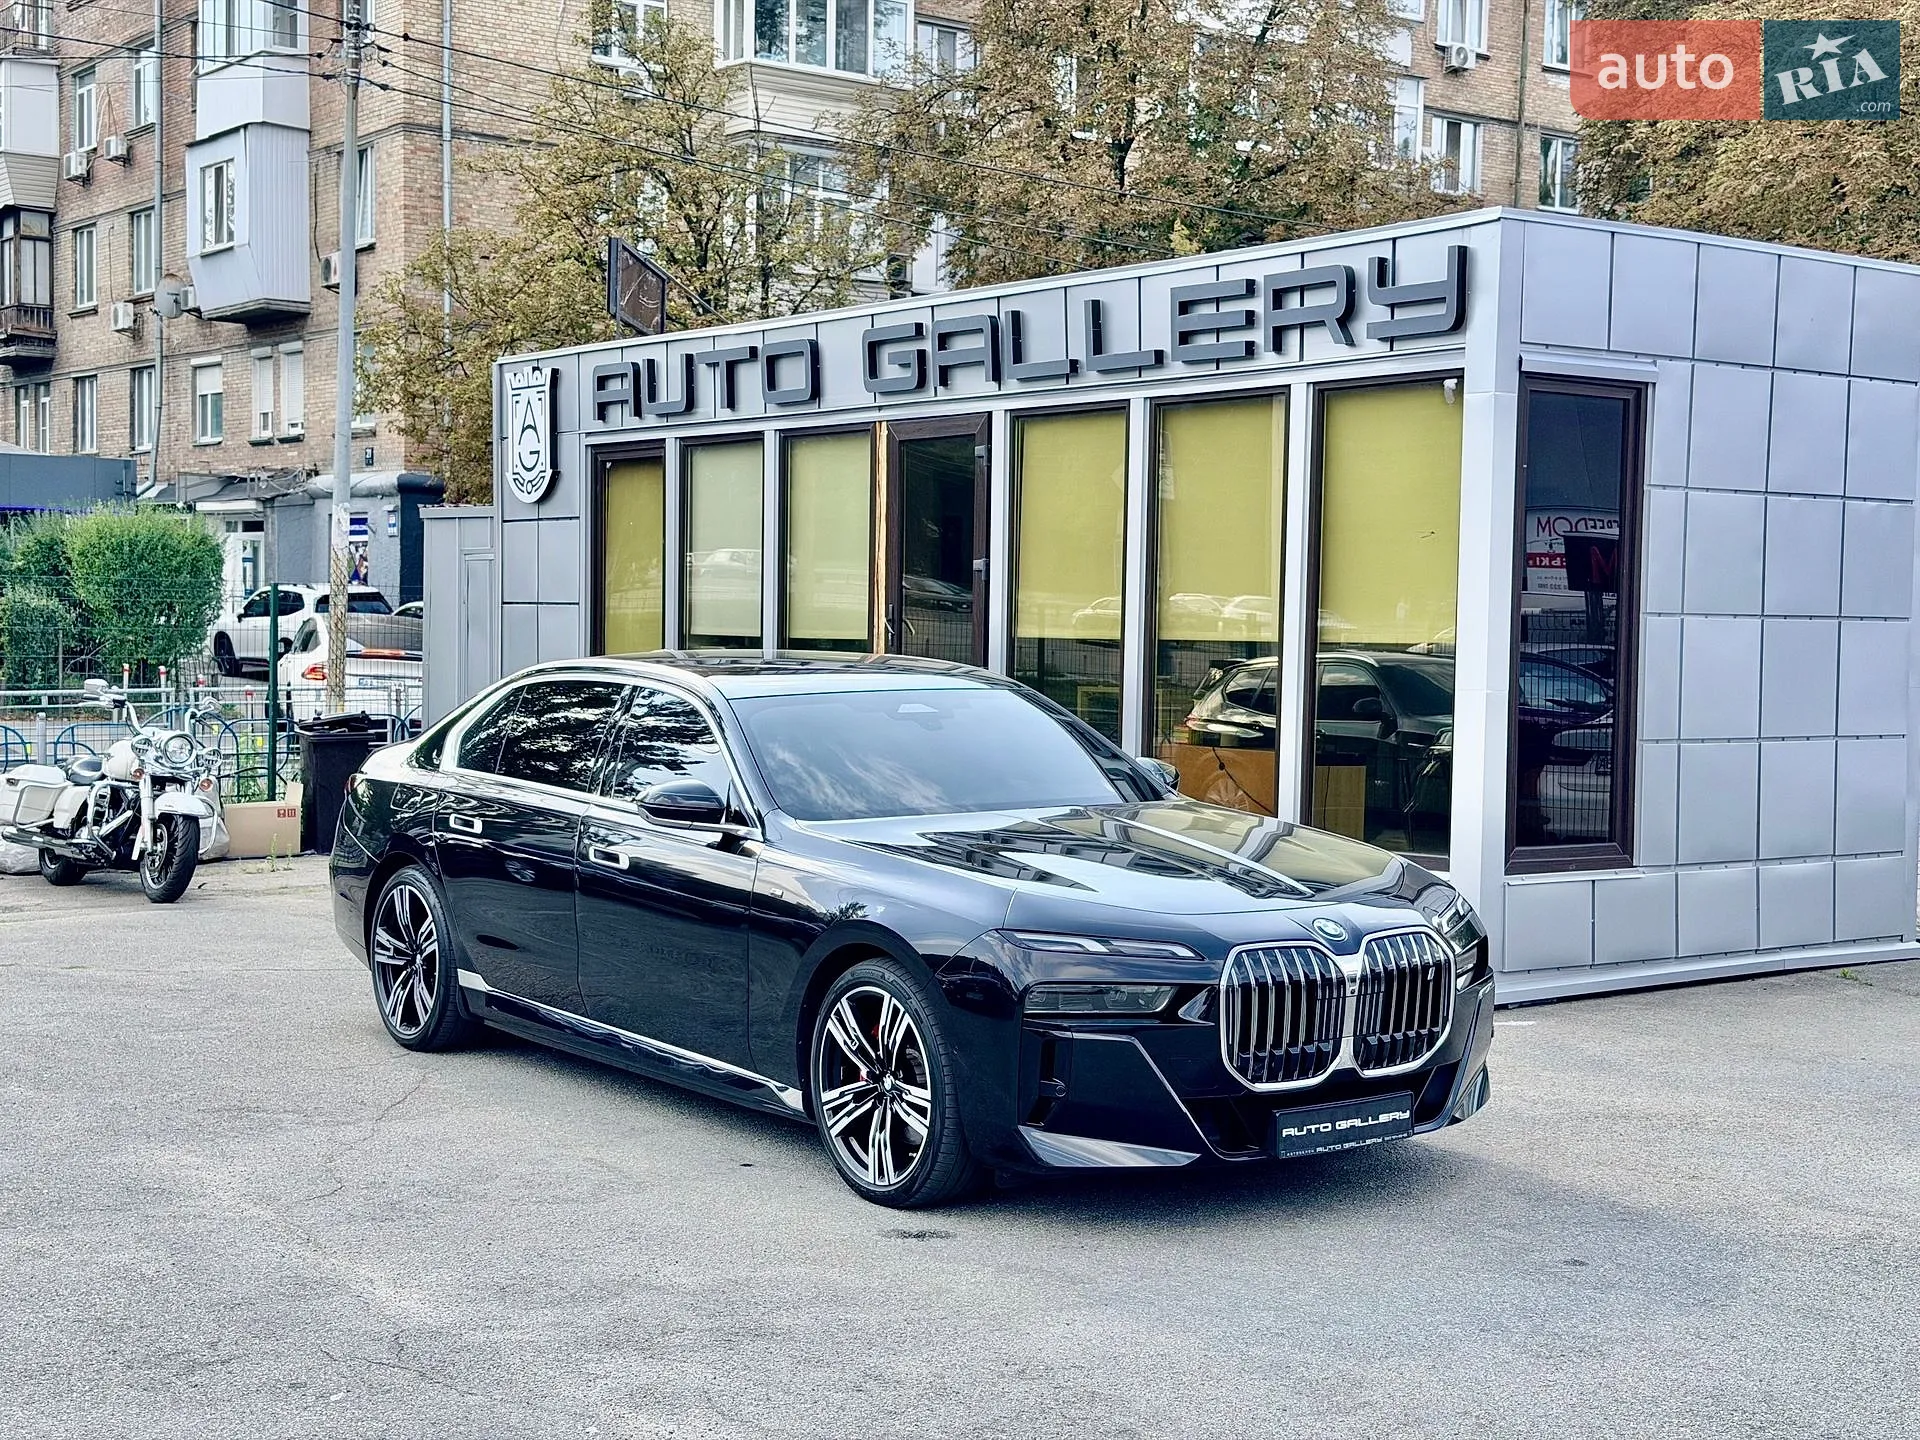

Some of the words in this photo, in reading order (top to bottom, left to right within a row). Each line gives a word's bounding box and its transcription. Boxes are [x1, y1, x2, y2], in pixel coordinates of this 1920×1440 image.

[593, 338, 821, 422] AUTO
[862, 244, 1469, 393] GALLERY
[1282, 1123, 1332, 1138] AUTO
[1336, 1110, 1410, 1130] GALLERY
[1316, 1144, 1342, 1153] AUTO
[1343, 1137, 1383, 1149] GALLERY
